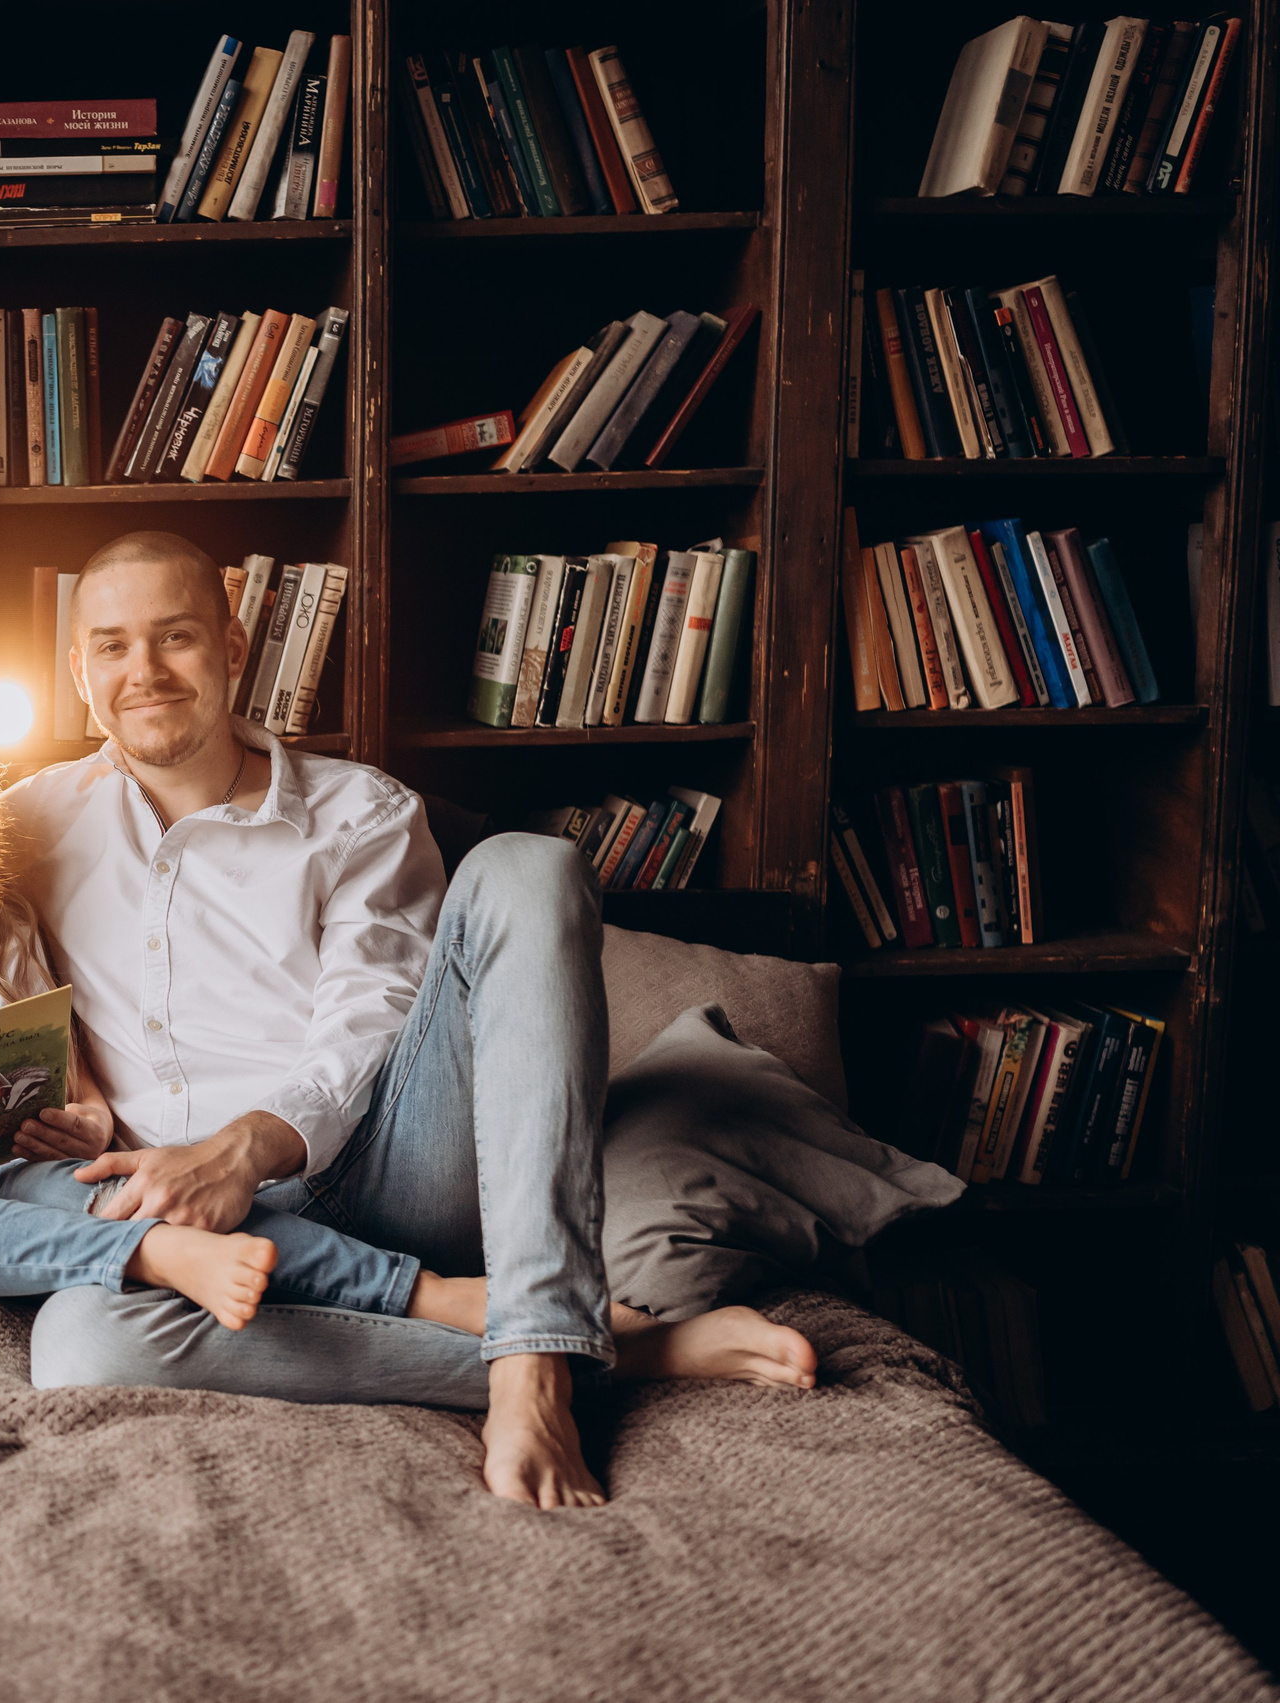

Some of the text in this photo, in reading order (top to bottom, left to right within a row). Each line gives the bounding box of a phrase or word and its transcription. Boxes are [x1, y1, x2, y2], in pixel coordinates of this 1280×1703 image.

[184, 57, 227, 159] Элементы теории гомологий
[296, 78, 320, 147] МАРИНИНА
[1095, 105, 1111, 134] МОДЕЛИ
[1103, 73, 1121, 104] ВЯЗАНОЙ
[1114, 39, 1132, 71] ОДЕЖДЫ
[64, 120, 128, 130] моей жизни
[72, 110, 116, 120] История
[514, 97, 533, 138] растения
[215, 146, 233, 182] ЕВГЕНИЙ
[222, 120, 251, 185] ДОЛМАТОВСКИЙ
[1111, 134, 1133, 189] Конец света
[280, 323, 307, 382] Татьяна Соломатина
[914, 303, 943, 394] ДЖЕК ЛОНДОН
[546, 359, 582, 411] АЛЕКСАНДР БЛОК
[139, 430, 160, 472] Американская
[155, 384, 179, 430] фантастическая
[288, 406, 314, 463] М.ГОРЬКИЙ
[243, 595, 256, 627] ТОЛСТОЙ
[272, 582, 294, 637] М.ГОРЬКИЙ
[294, 588, 316, 629] ОЖОГ
[594, 572, 626, 693] ВАЦЛАВ МИХАЛЬСКИЙ
[307, 620, 329, 681] А.С.ПУШКИН
[1061, 631, 1078, 669] МАУГЛИ
